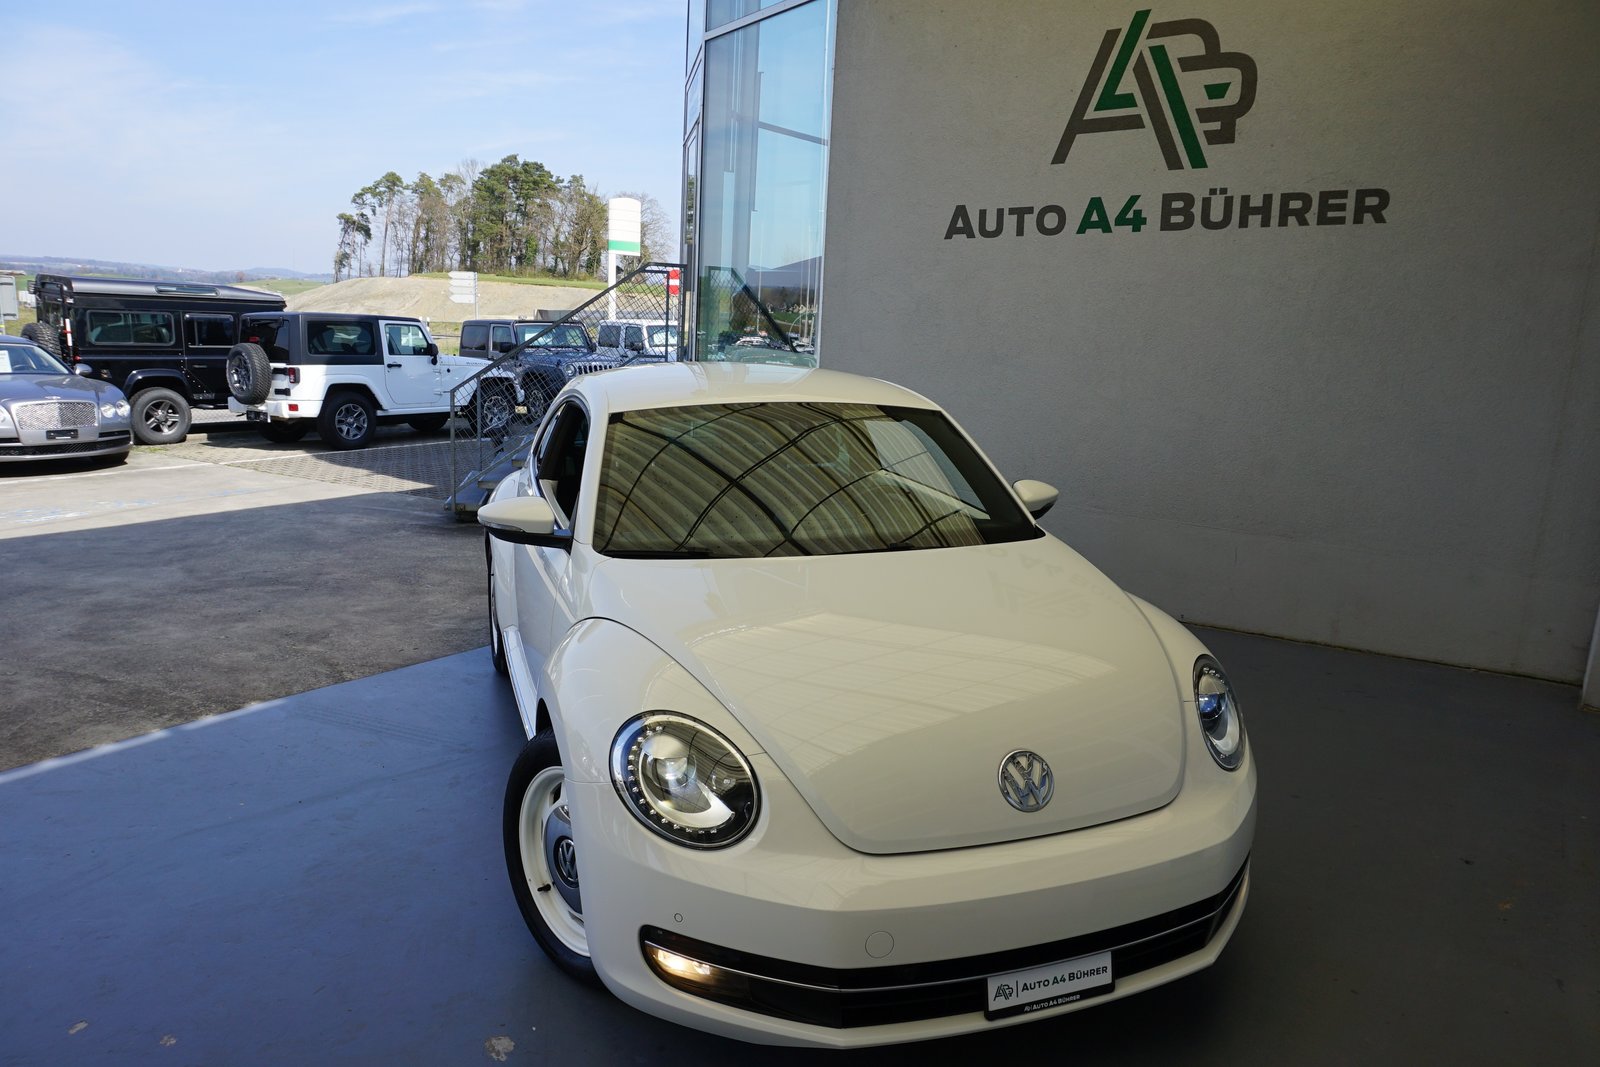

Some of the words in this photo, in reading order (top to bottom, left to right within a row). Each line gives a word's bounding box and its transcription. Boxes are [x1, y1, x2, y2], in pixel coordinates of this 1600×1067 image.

[944, 204, 1067, 240] AUTO
[1076, 195, 1147, 235] A4
[1160, 188, 1391, 231] BÜHRER
[1000, 752, 1052, 810] VW
[1021, 979, 1050, 992] AUTO
[1052, 975, 1067, 985] A4
[1068, 966, 1108, 981] BÜHRER
[1033, 1002, 1048, 1010] AUTO
